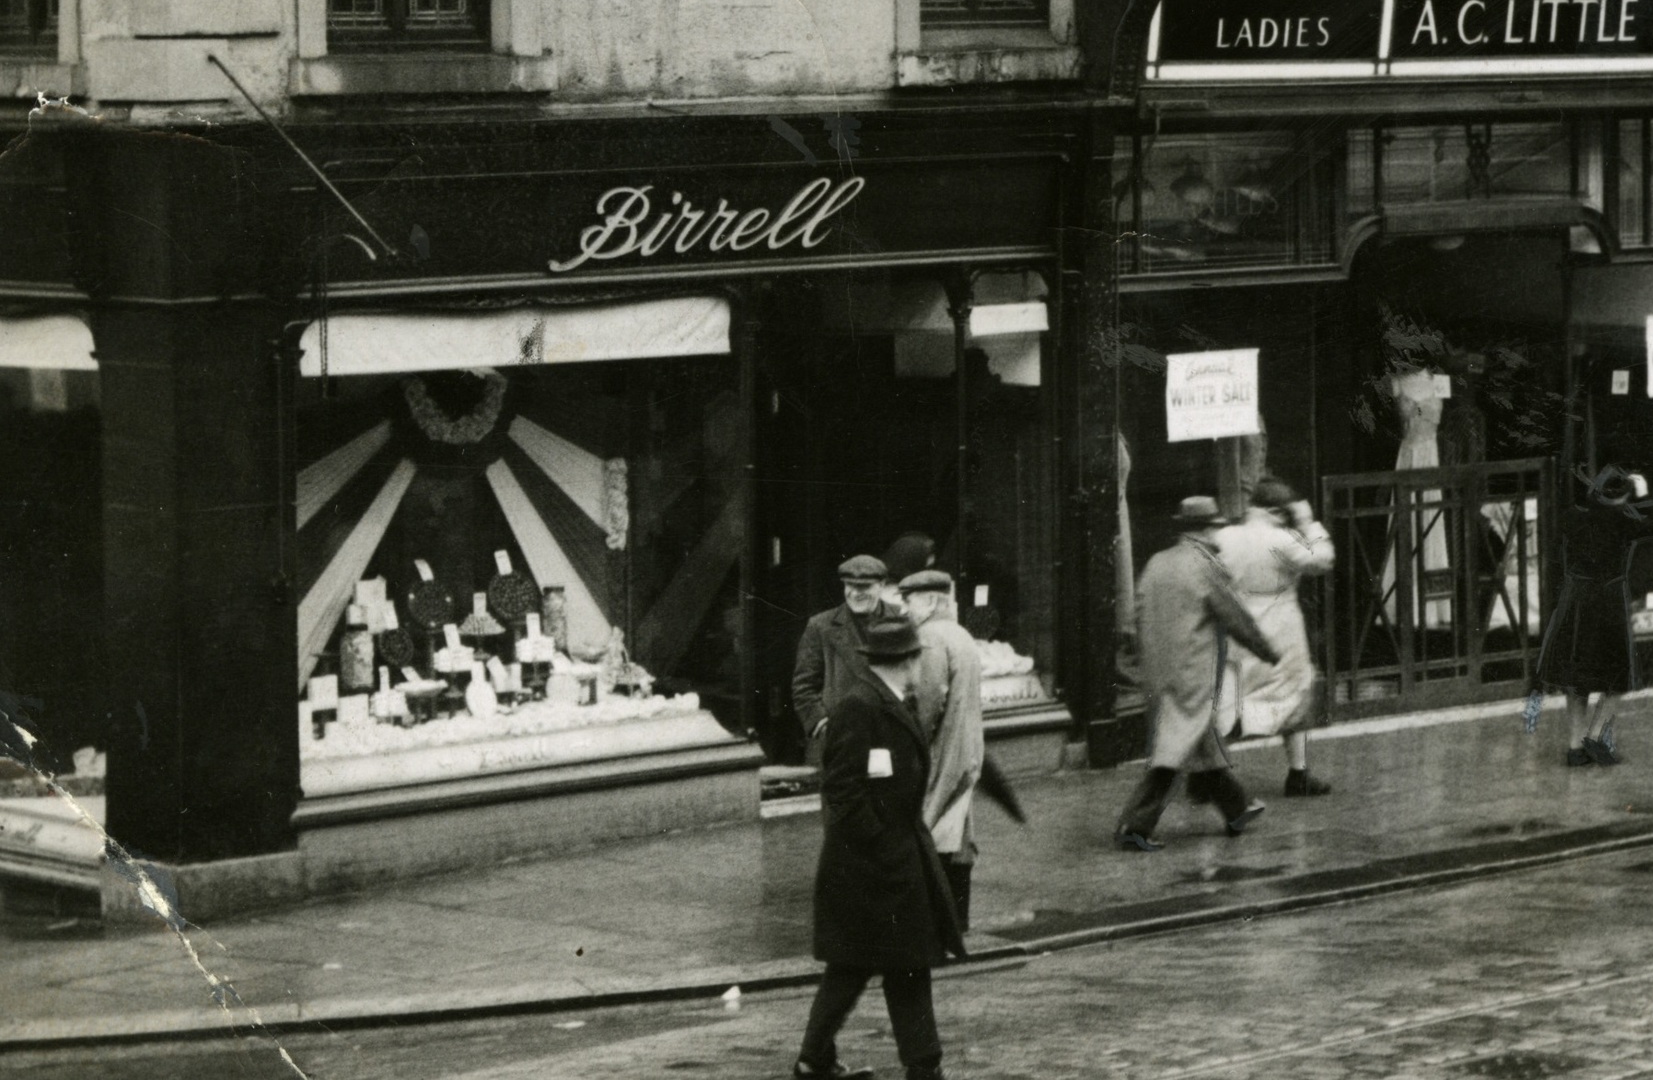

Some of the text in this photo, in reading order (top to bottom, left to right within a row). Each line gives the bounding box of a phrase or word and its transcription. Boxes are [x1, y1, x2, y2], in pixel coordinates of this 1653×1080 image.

[1215, 16, 1331, 49] LADIES
[548, 175, 866, 273] Birrell
[1170, 382, 1251, 408] WINTER SALE
